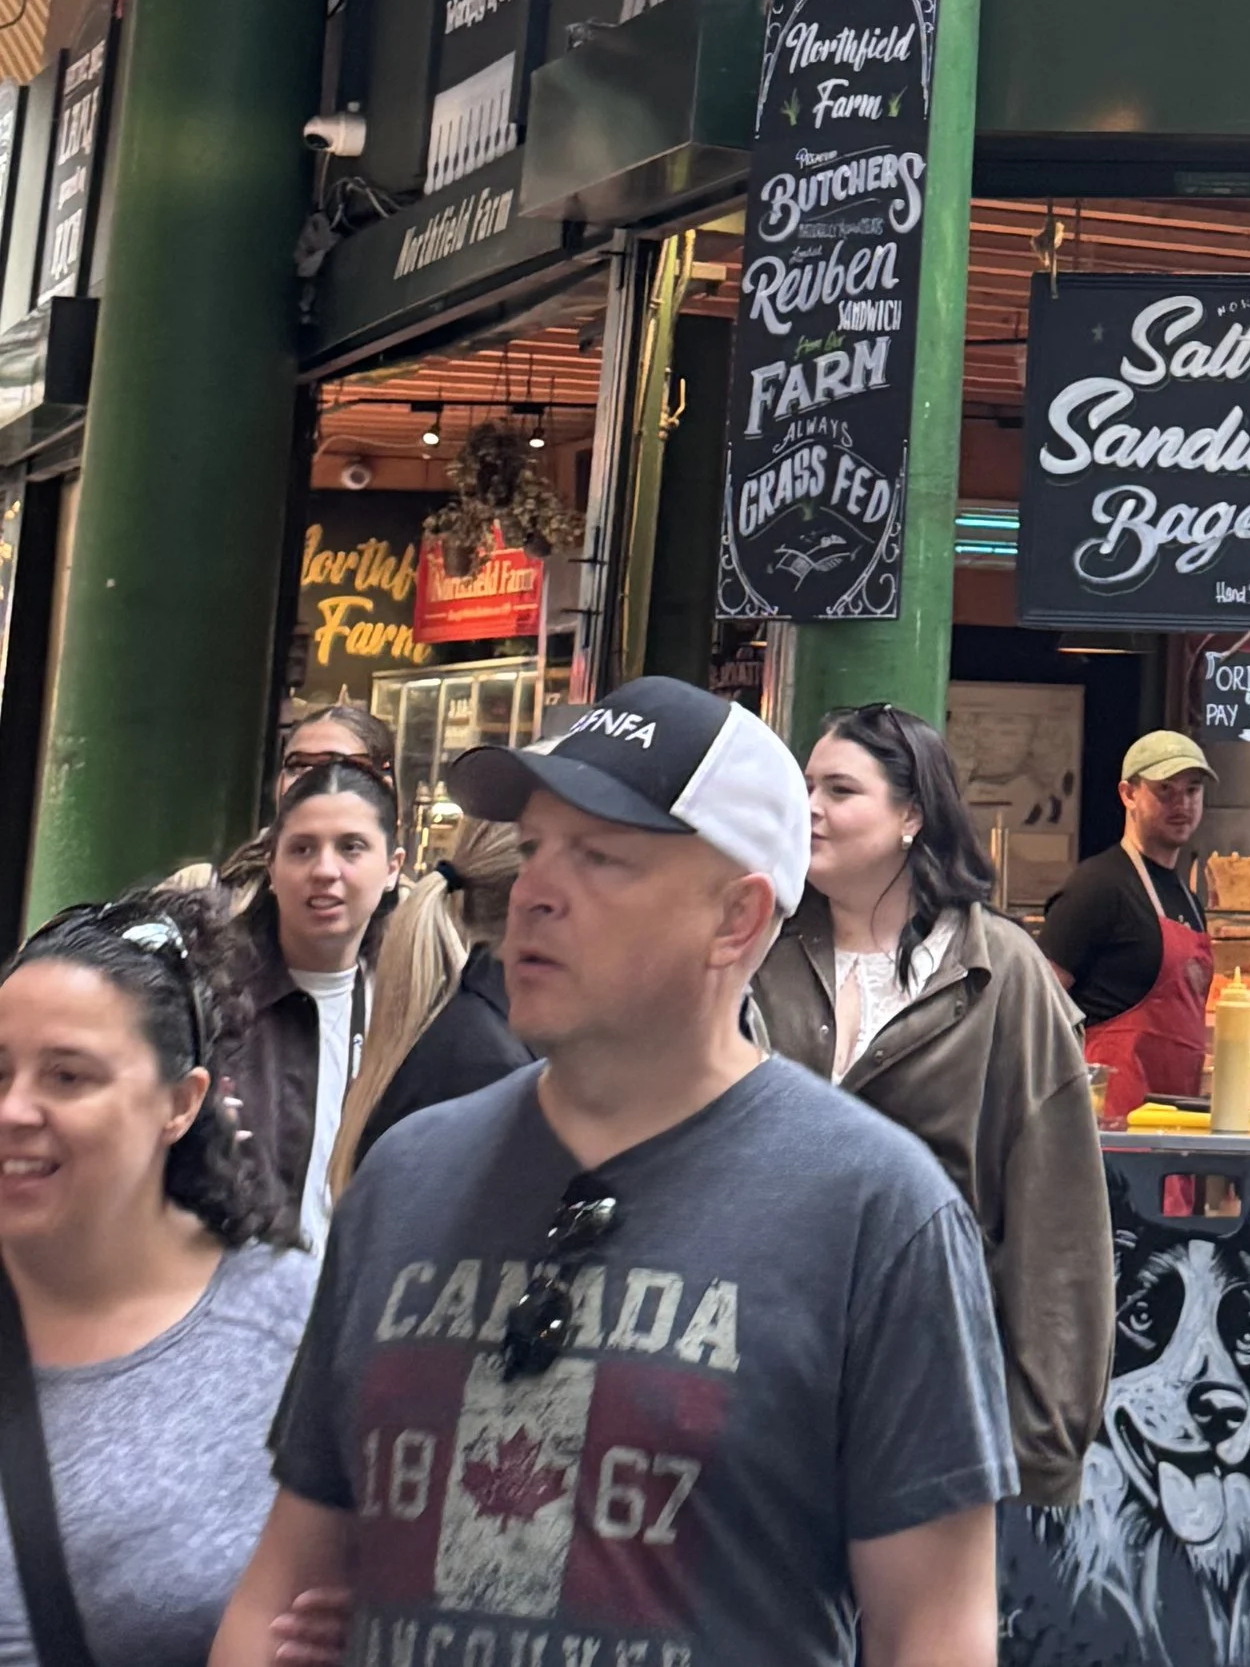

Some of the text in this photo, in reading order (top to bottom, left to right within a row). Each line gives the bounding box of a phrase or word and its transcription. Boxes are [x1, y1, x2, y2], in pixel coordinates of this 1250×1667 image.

[785, 22, 916, 75] Northfield
[812, 78, 884, 129] Farm
[470, 187, 514, 245] Farm
[742, 239, 900, 334] Reuben
[837, 300, 902, 331] SANDWICH
[745, 336, 891, 440] FARM
[773, 416, 853, 454] ALWAYS
[739, 445, 890, 538] GRASS FED
[1216, 581, 1247, 604] Hand
[1206, 703, 1239, 727] PAY
[374, 1258, 741, 1373] CANADA
[359, 1429, 702, 1546] 18 67
